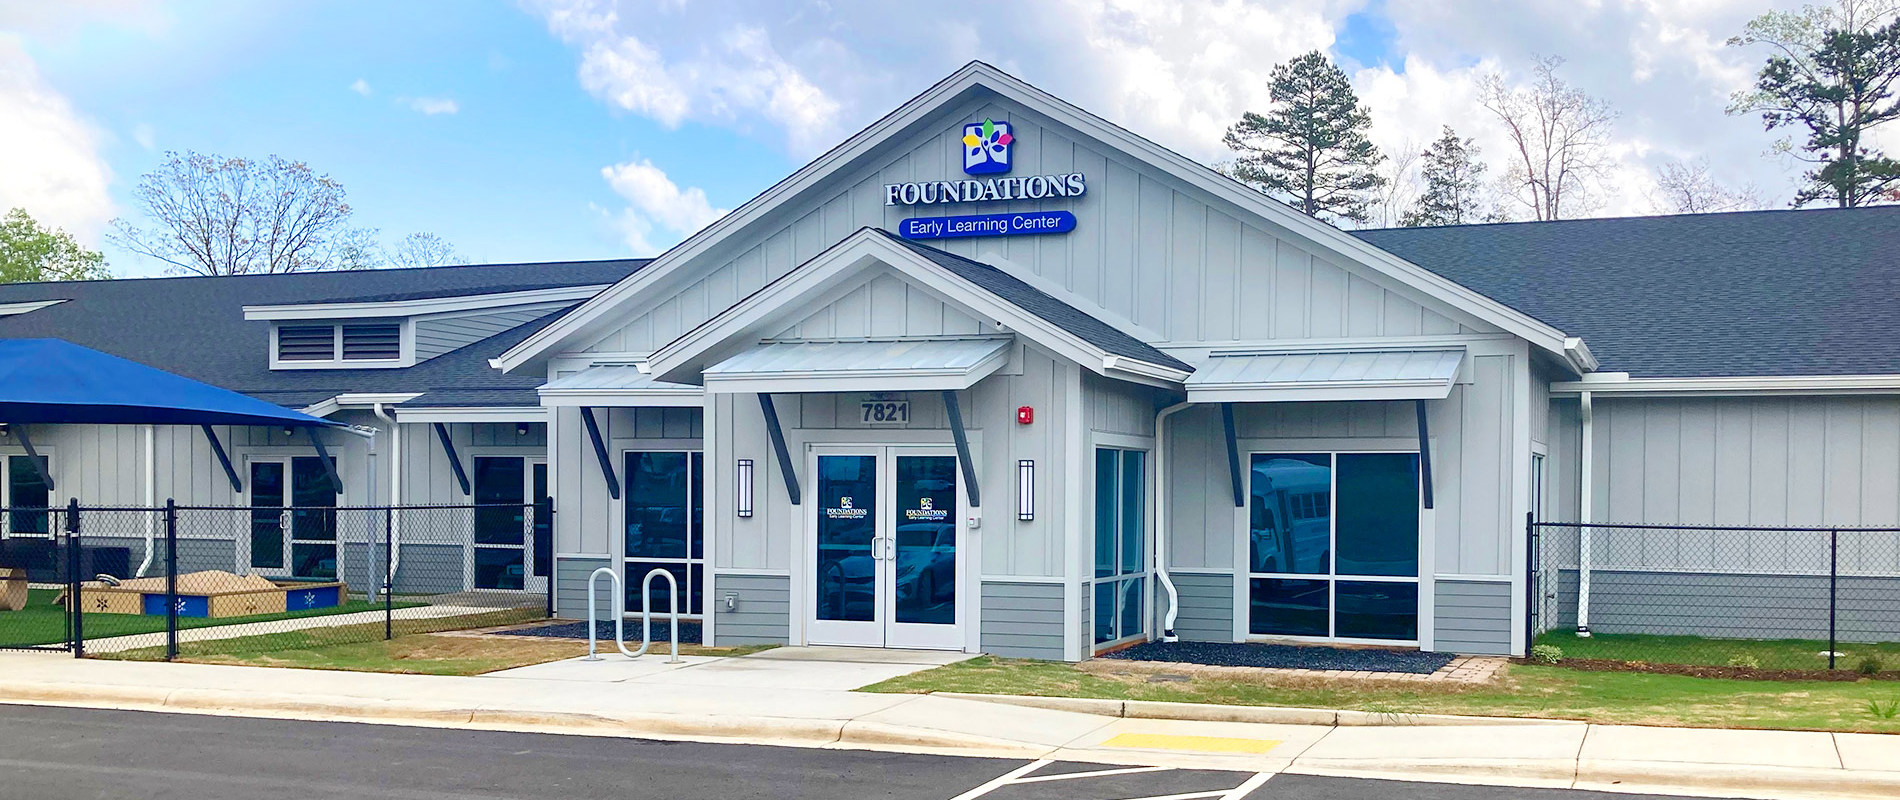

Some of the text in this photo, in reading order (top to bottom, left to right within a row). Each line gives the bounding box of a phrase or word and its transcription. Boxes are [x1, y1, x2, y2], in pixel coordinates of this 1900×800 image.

[884, 172, 1086, 206] FOUNDATIONS
[910, 215, 1061, 236] Early Learning Center
[861, 402, 907, 422] 7821
[826, 508, 868, 516] FOUNDATIONS
[905, 509, 948, 517] FOUNDATIONS
